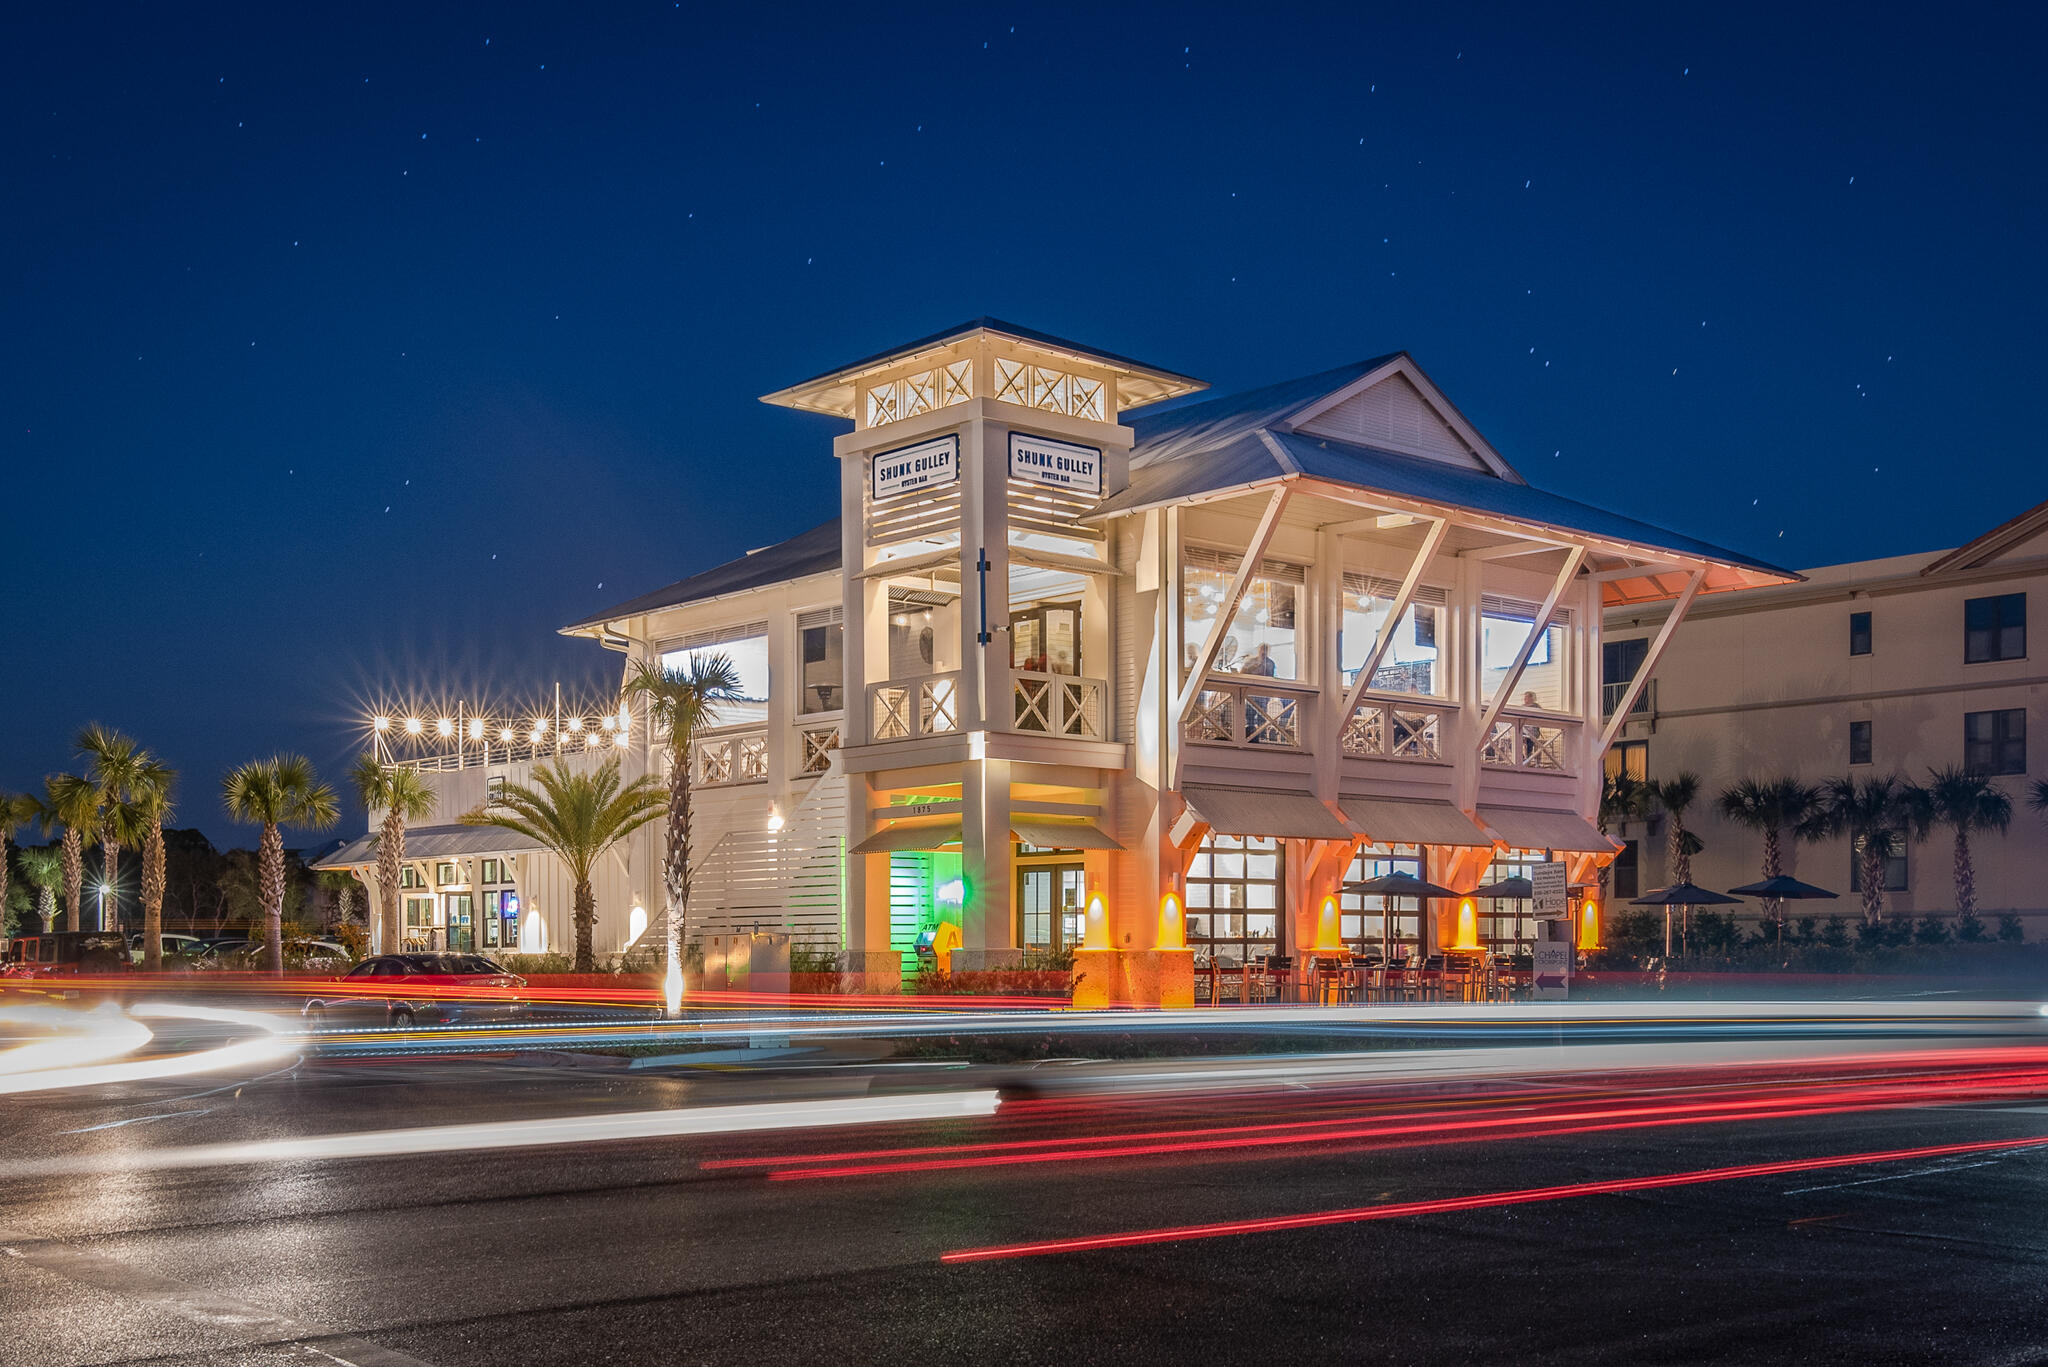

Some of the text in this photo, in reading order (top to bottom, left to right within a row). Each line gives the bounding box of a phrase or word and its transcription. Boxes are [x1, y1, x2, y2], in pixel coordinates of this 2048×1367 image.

[880, 451, 950, 481] SHUNK GULLEY
[1017, 449, 1094, 475] SHUNK GULLEY
[901, 475, 928, 487] OYSTER BAR
[1041, 471, 1070, 482] OYSTER BAR
[912, 805, 931, 814] 1875
[1538, 949, 1568, 960] CHAPEL
